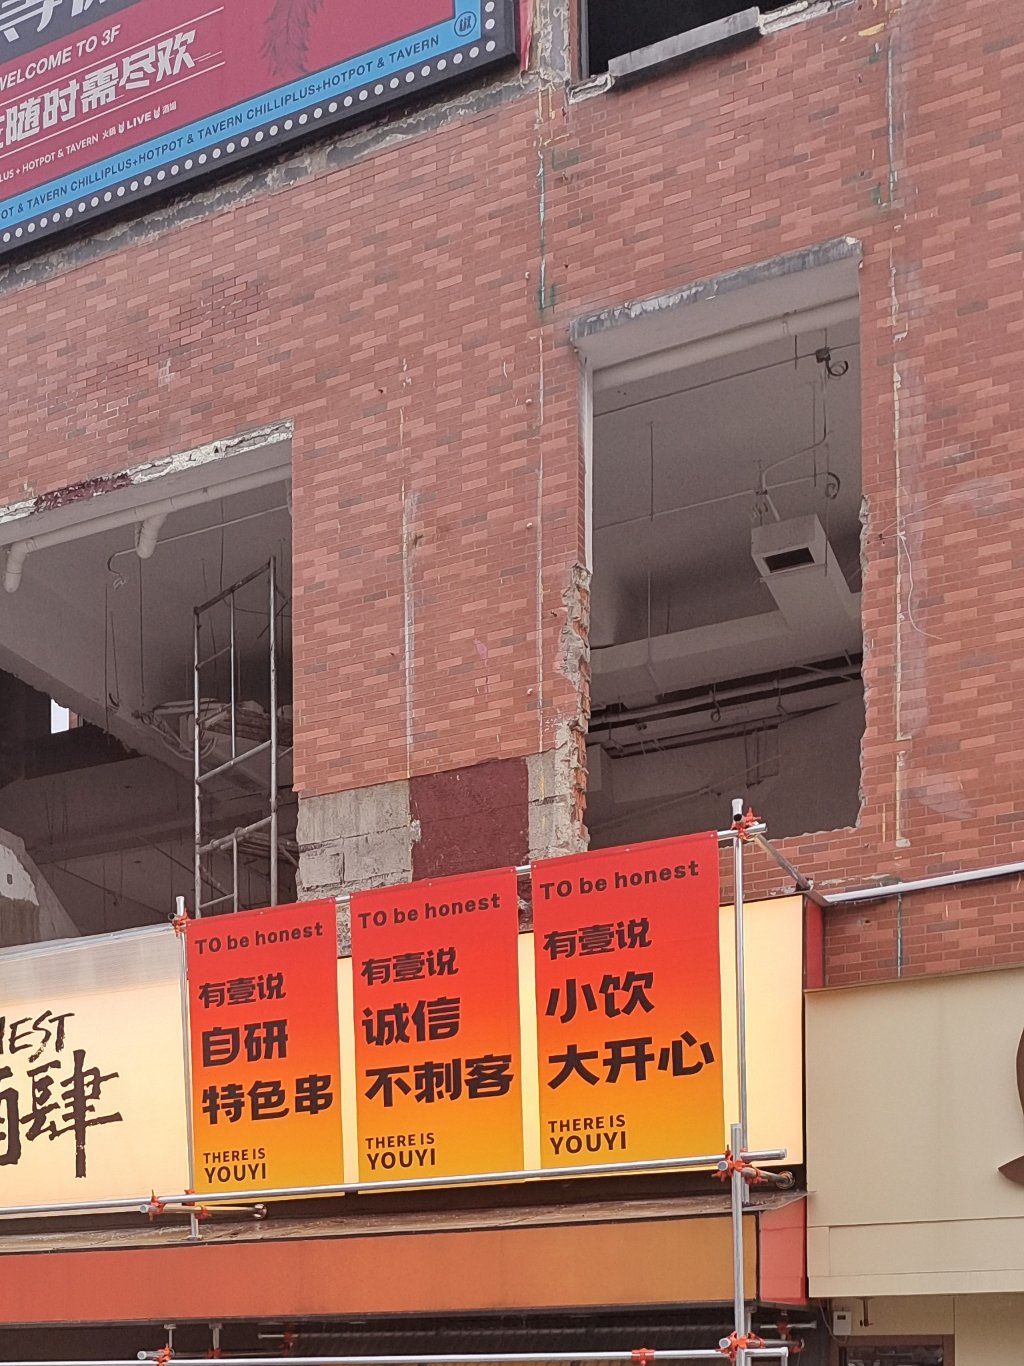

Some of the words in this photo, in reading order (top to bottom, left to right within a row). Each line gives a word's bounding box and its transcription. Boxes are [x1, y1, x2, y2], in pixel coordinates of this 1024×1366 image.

[77, 36, 98, 57] TO
[102, 24, 121, 45] 3F
[18, 203, 24, 213] &
[27, 186, 67, 208] TAVERN
[187, 133, 194, 143] &
[198, 113, 243, 138] TAVERN
[376, 57, 384, 68] &
[389, 35, 440, 64] TAVERN
[22, 153, 56, 173] HOTPOT
[57, 148, 64, 158] &
[66, 134, 99, 155] TAVERN
[126, 112, 151, 129] LIVE
[540, 881, 572, 900] TO
[579, 875, 607, 895] be
[613, 860, 699, 889] honest
[358, 911, 387, 929] TO
[392, 906, 419, 925] be
[424, 893, 501, 920] honest
[195, 937, 222, 955] TO
[226, 933, 250, 951] be
[255, 921, 323, 944] honest
[543, 918, 652, 961] 有壹说
[360, 946, 459, 986] 有壹说
[198, 972, 287, 1009] 有壹说
[545, 970, 655, 1023] 小饮
[362, 996, 461, 1046] 诚信
[201, 1019, 289, 1068] 自研
[547, 1031, 715, 1090] 大开心
[201, 1074, 334, 1125] 特色串
[365, 1053, 514, 1108] 不刺客
[365, 1135, 416, 1150] THERE
[419, 1132, 435, 1146] IS
[548, 1118, 605, 1134] THERE
[609, 1114, 626, 1128] IS
[549, 1130, 627, 1156] YOUYI
[203, 1150, 249, 1165] THERE
[253, 1148, 265, 1160] IS
[204, 1163, 267, 1184] YOUYI
[366, 1148, 437, 1171] YOUYI
